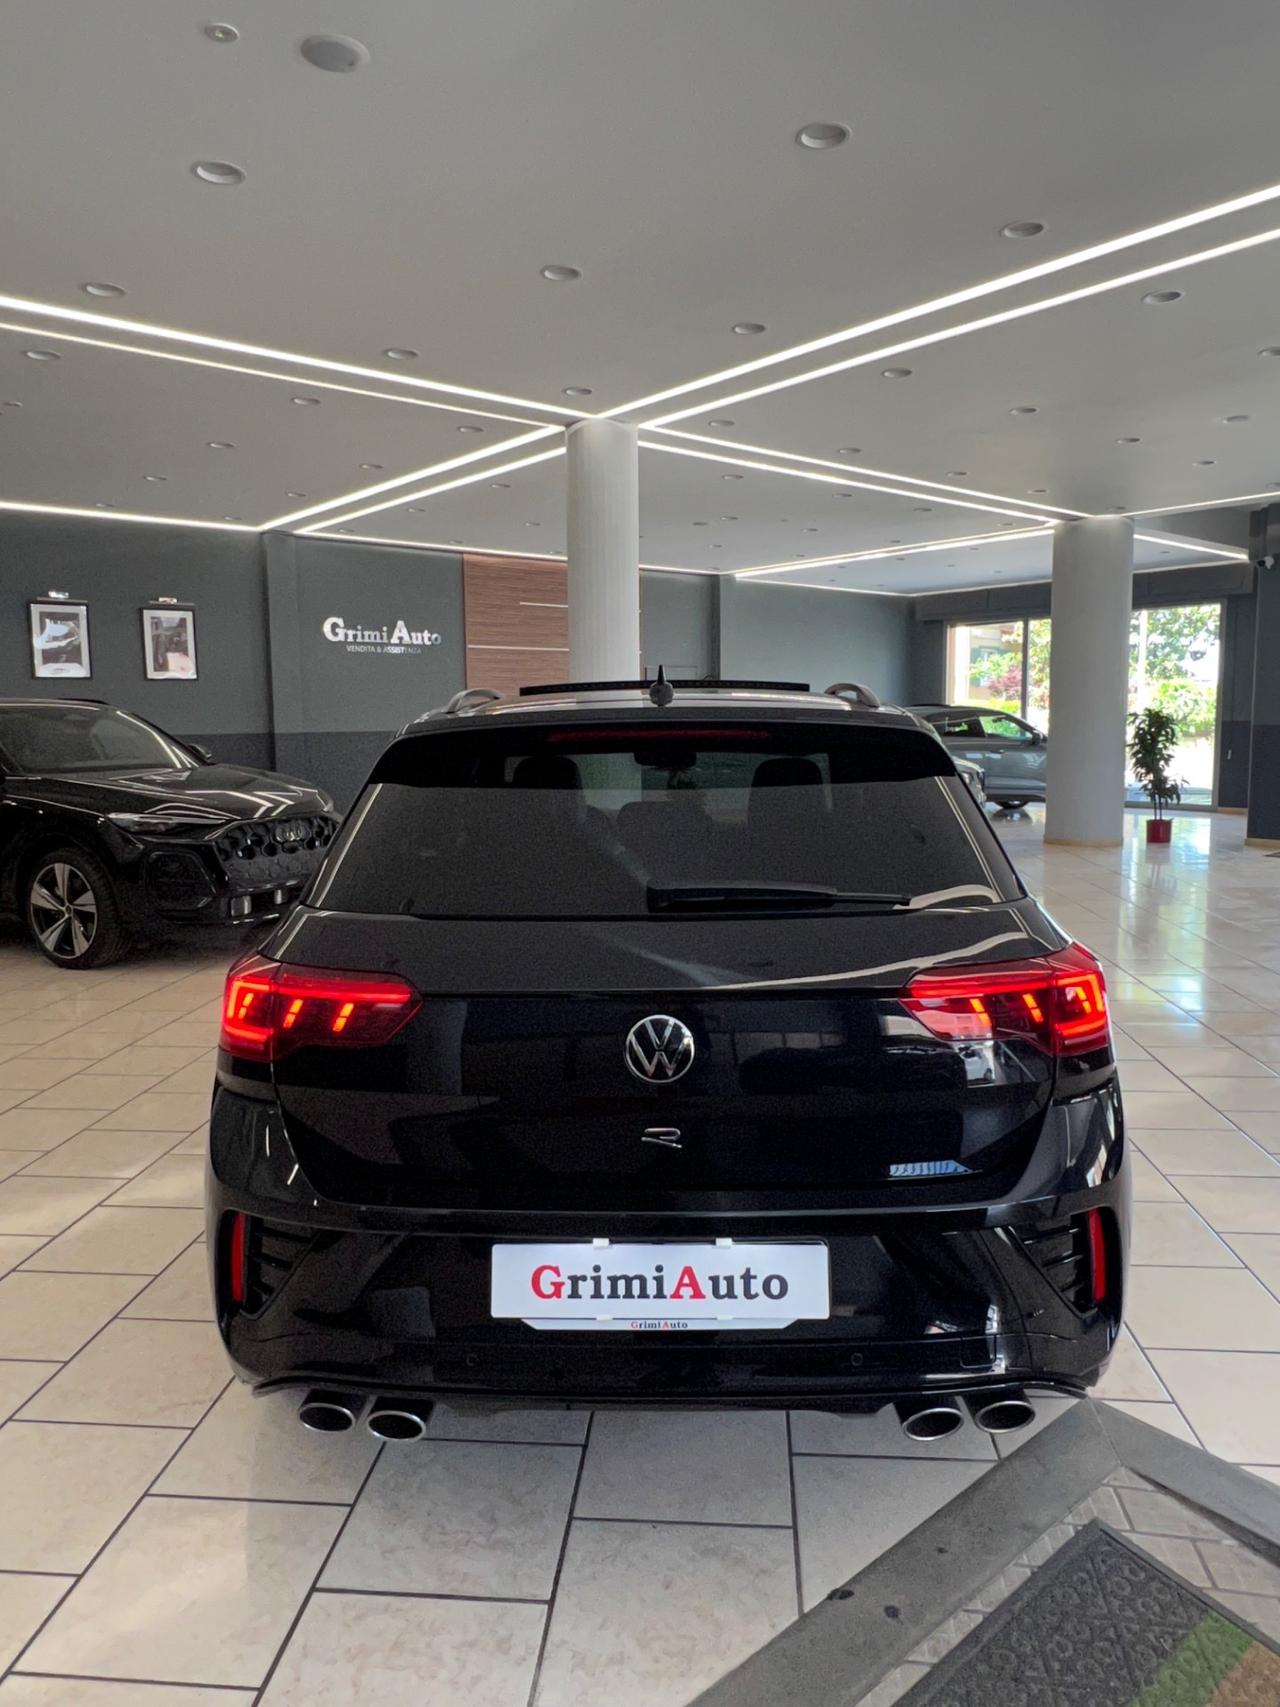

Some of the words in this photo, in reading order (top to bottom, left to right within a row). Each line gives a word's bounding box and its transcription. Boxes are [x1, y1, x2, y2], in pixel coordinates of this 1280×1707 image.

[346, 645, 375, 653] VENDITA
[530, 1264, 789, 1300] GrimiAuto
[630, 1320, 688, 1329] GrimiAuto
